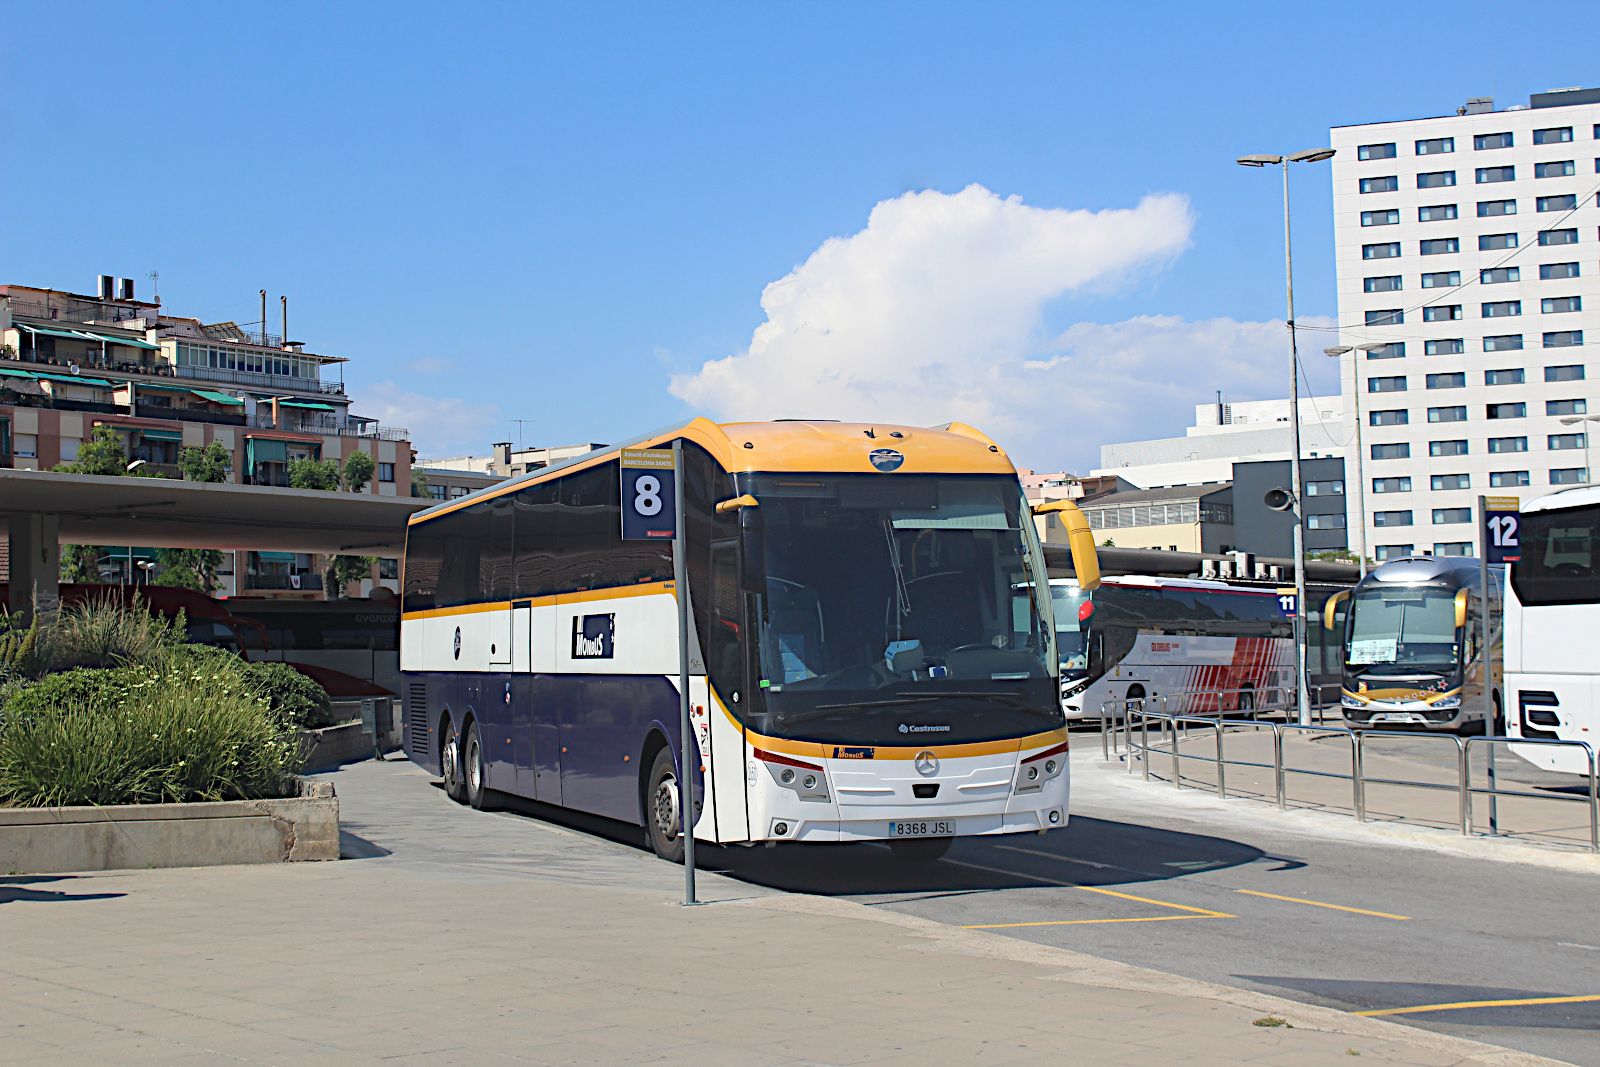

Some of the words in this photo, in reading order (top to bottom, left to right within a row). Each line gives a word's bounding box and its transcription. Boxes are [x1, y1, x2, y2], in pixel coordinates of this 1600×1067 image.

[634, 475, 662, 516] 8
[1486, 515, 1518, 546] 12
[1278, 595, 1295, 610] 11
[1151, 642, 1171, 652] GLOBUS
[897, 822, 927, 835] 8368
[931, 821, 953, 834] JSL
